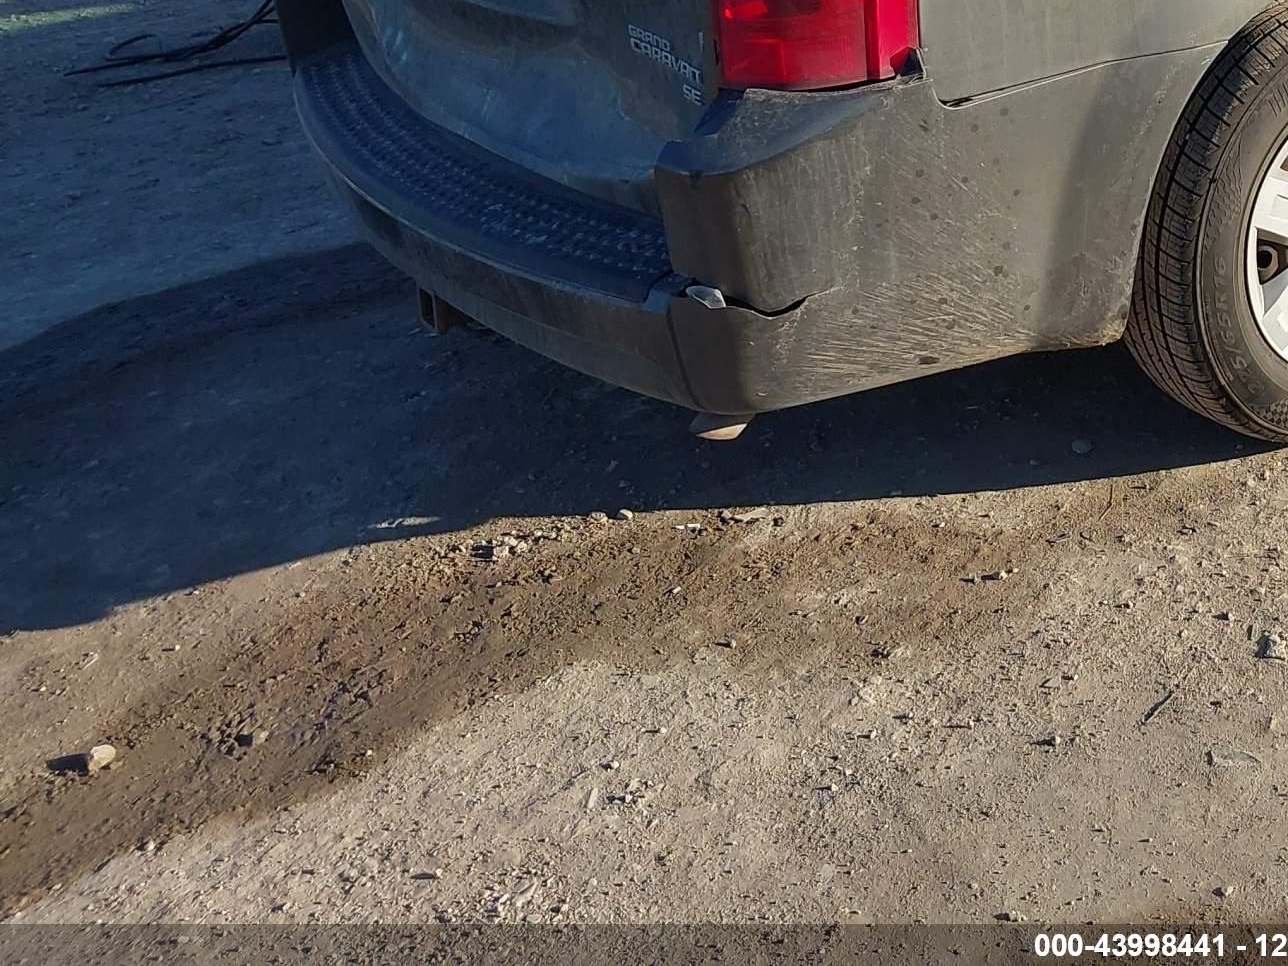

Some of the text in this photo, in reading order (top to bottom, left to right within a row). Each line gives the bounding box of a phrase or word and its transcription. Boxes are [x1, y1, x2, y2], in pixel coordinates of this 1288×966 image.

[627, 24, 671, 51] GRAND
[629, 37, 702, 84] CARAVAN
[682, 83, 704, 106] SE
